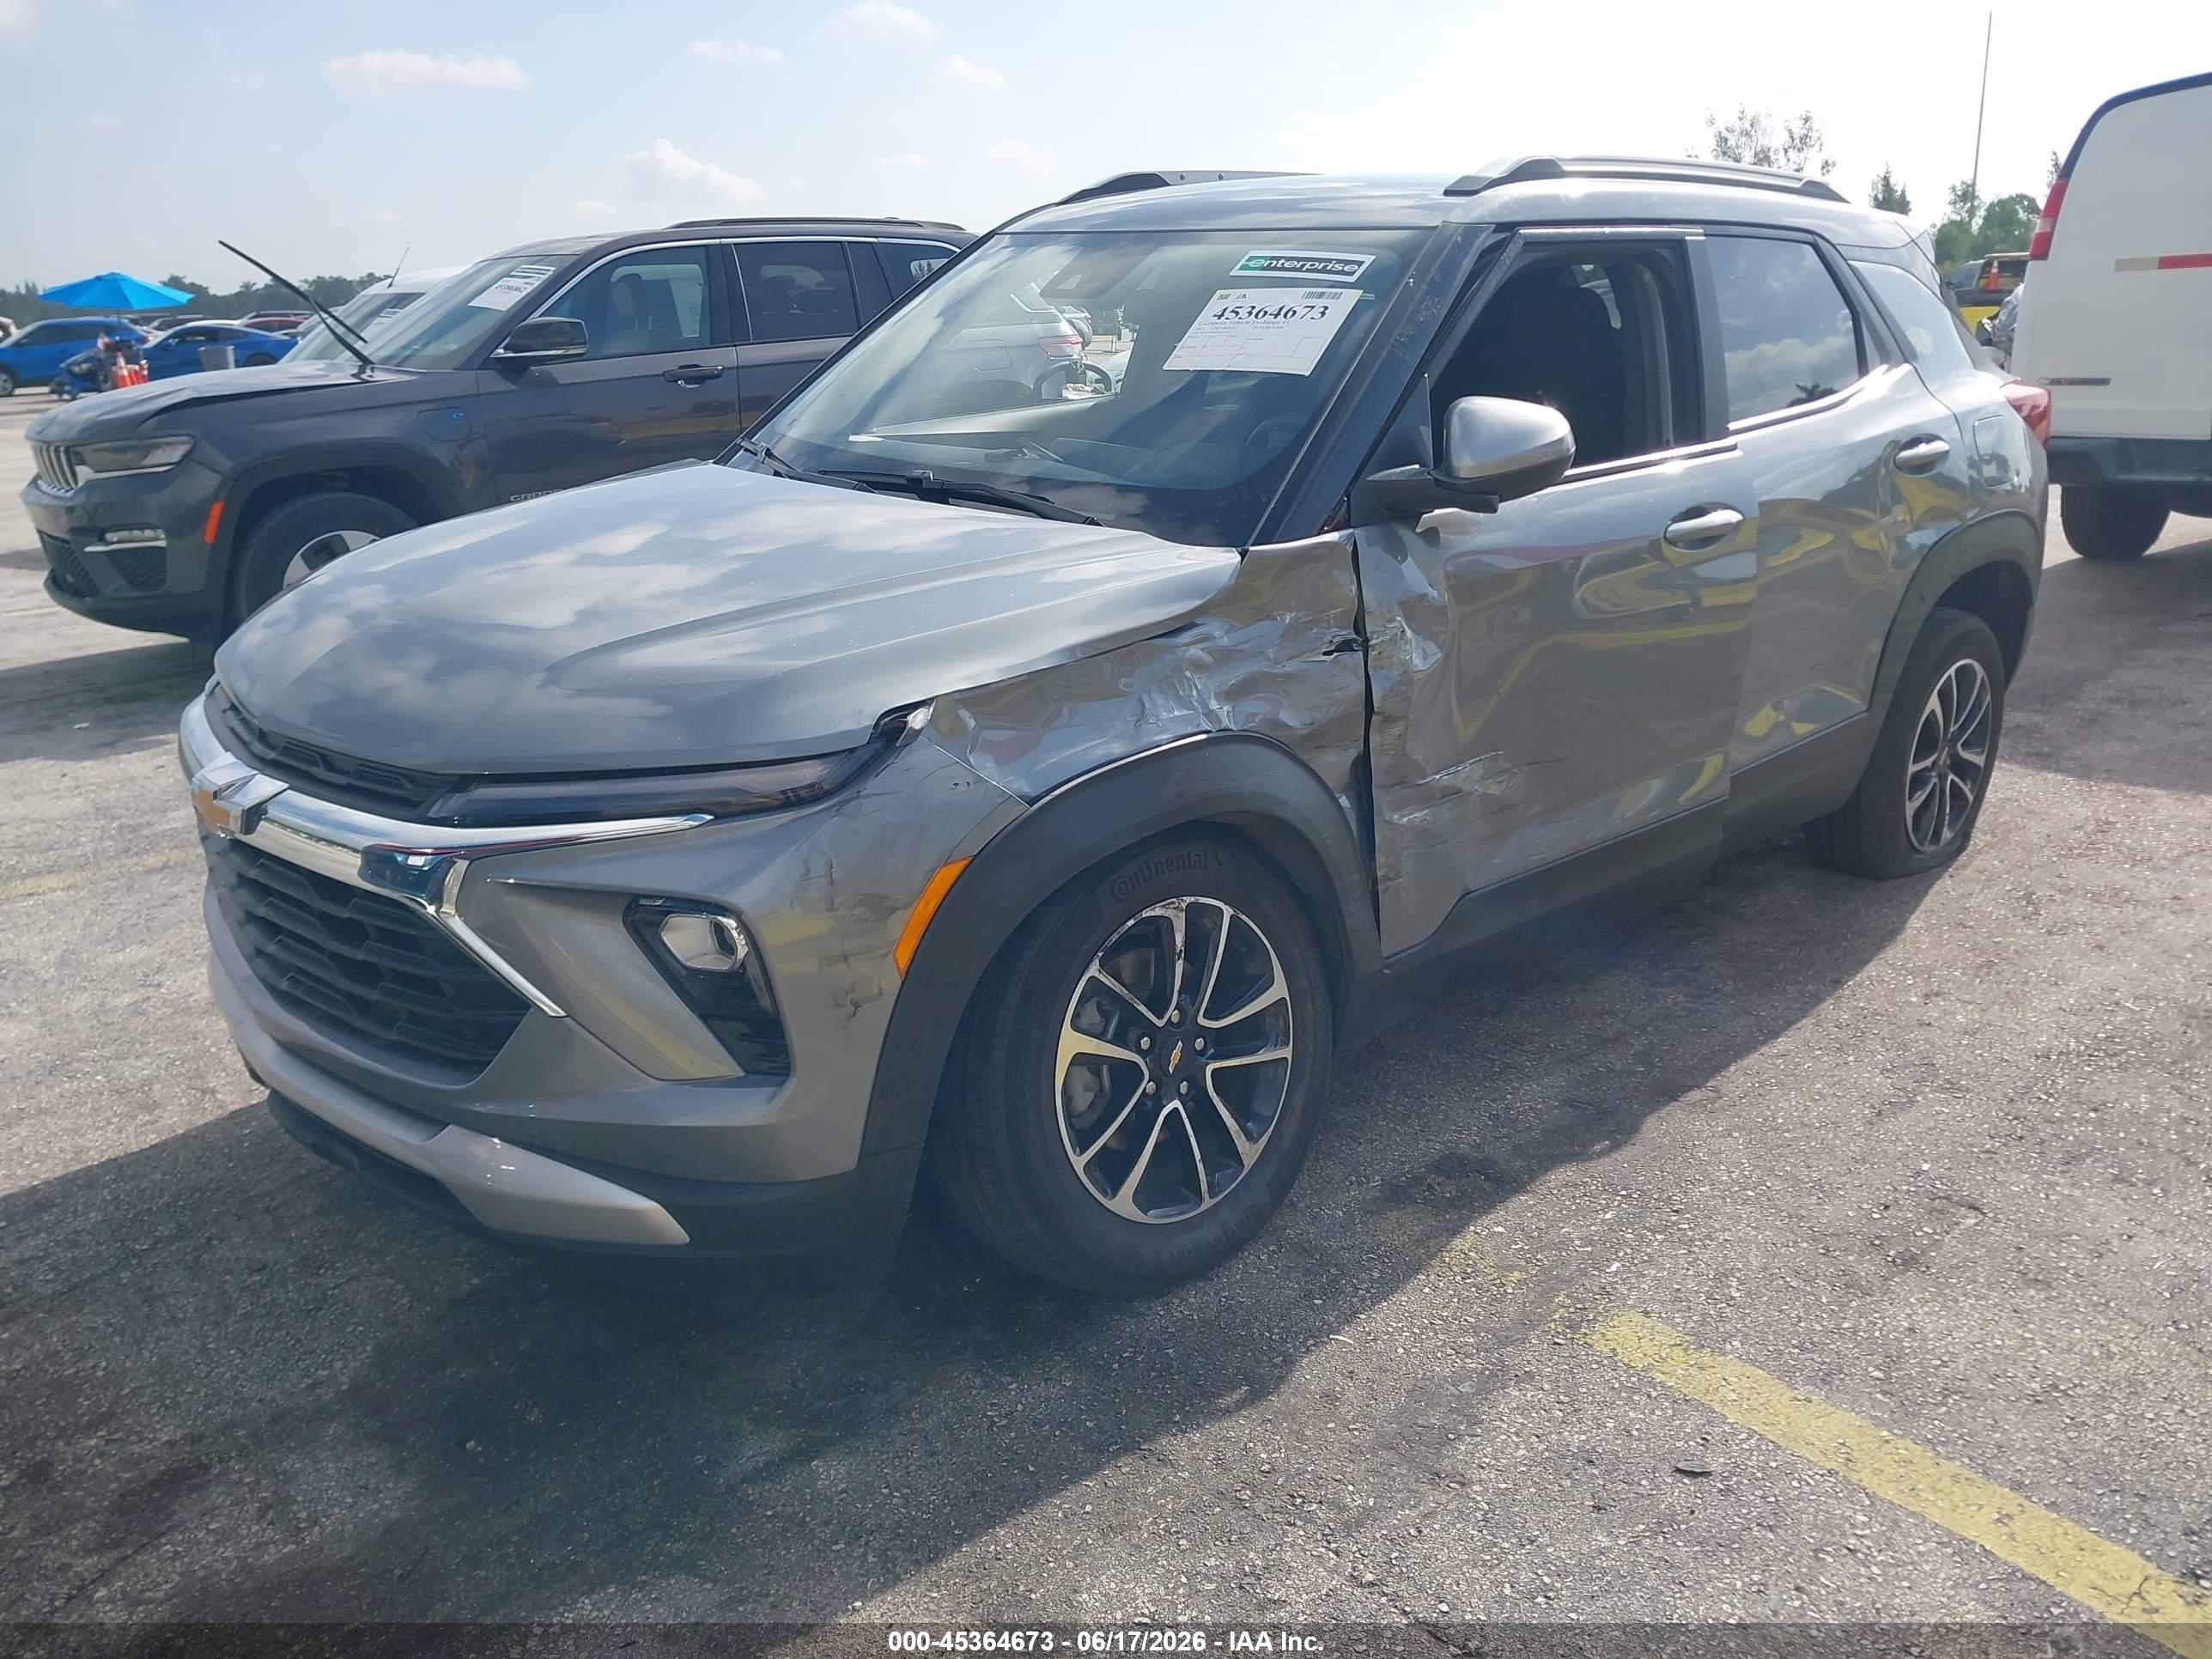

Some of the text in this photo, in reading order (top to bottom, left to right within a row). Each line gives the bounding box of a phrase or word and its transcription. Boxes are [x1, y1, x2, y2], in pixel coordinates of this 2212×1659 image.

[1244, 257, 1358, 273] enterprise
[1212, 303, 1330, 321] 45364673
[1109, 849, 1208, 902] Continental
